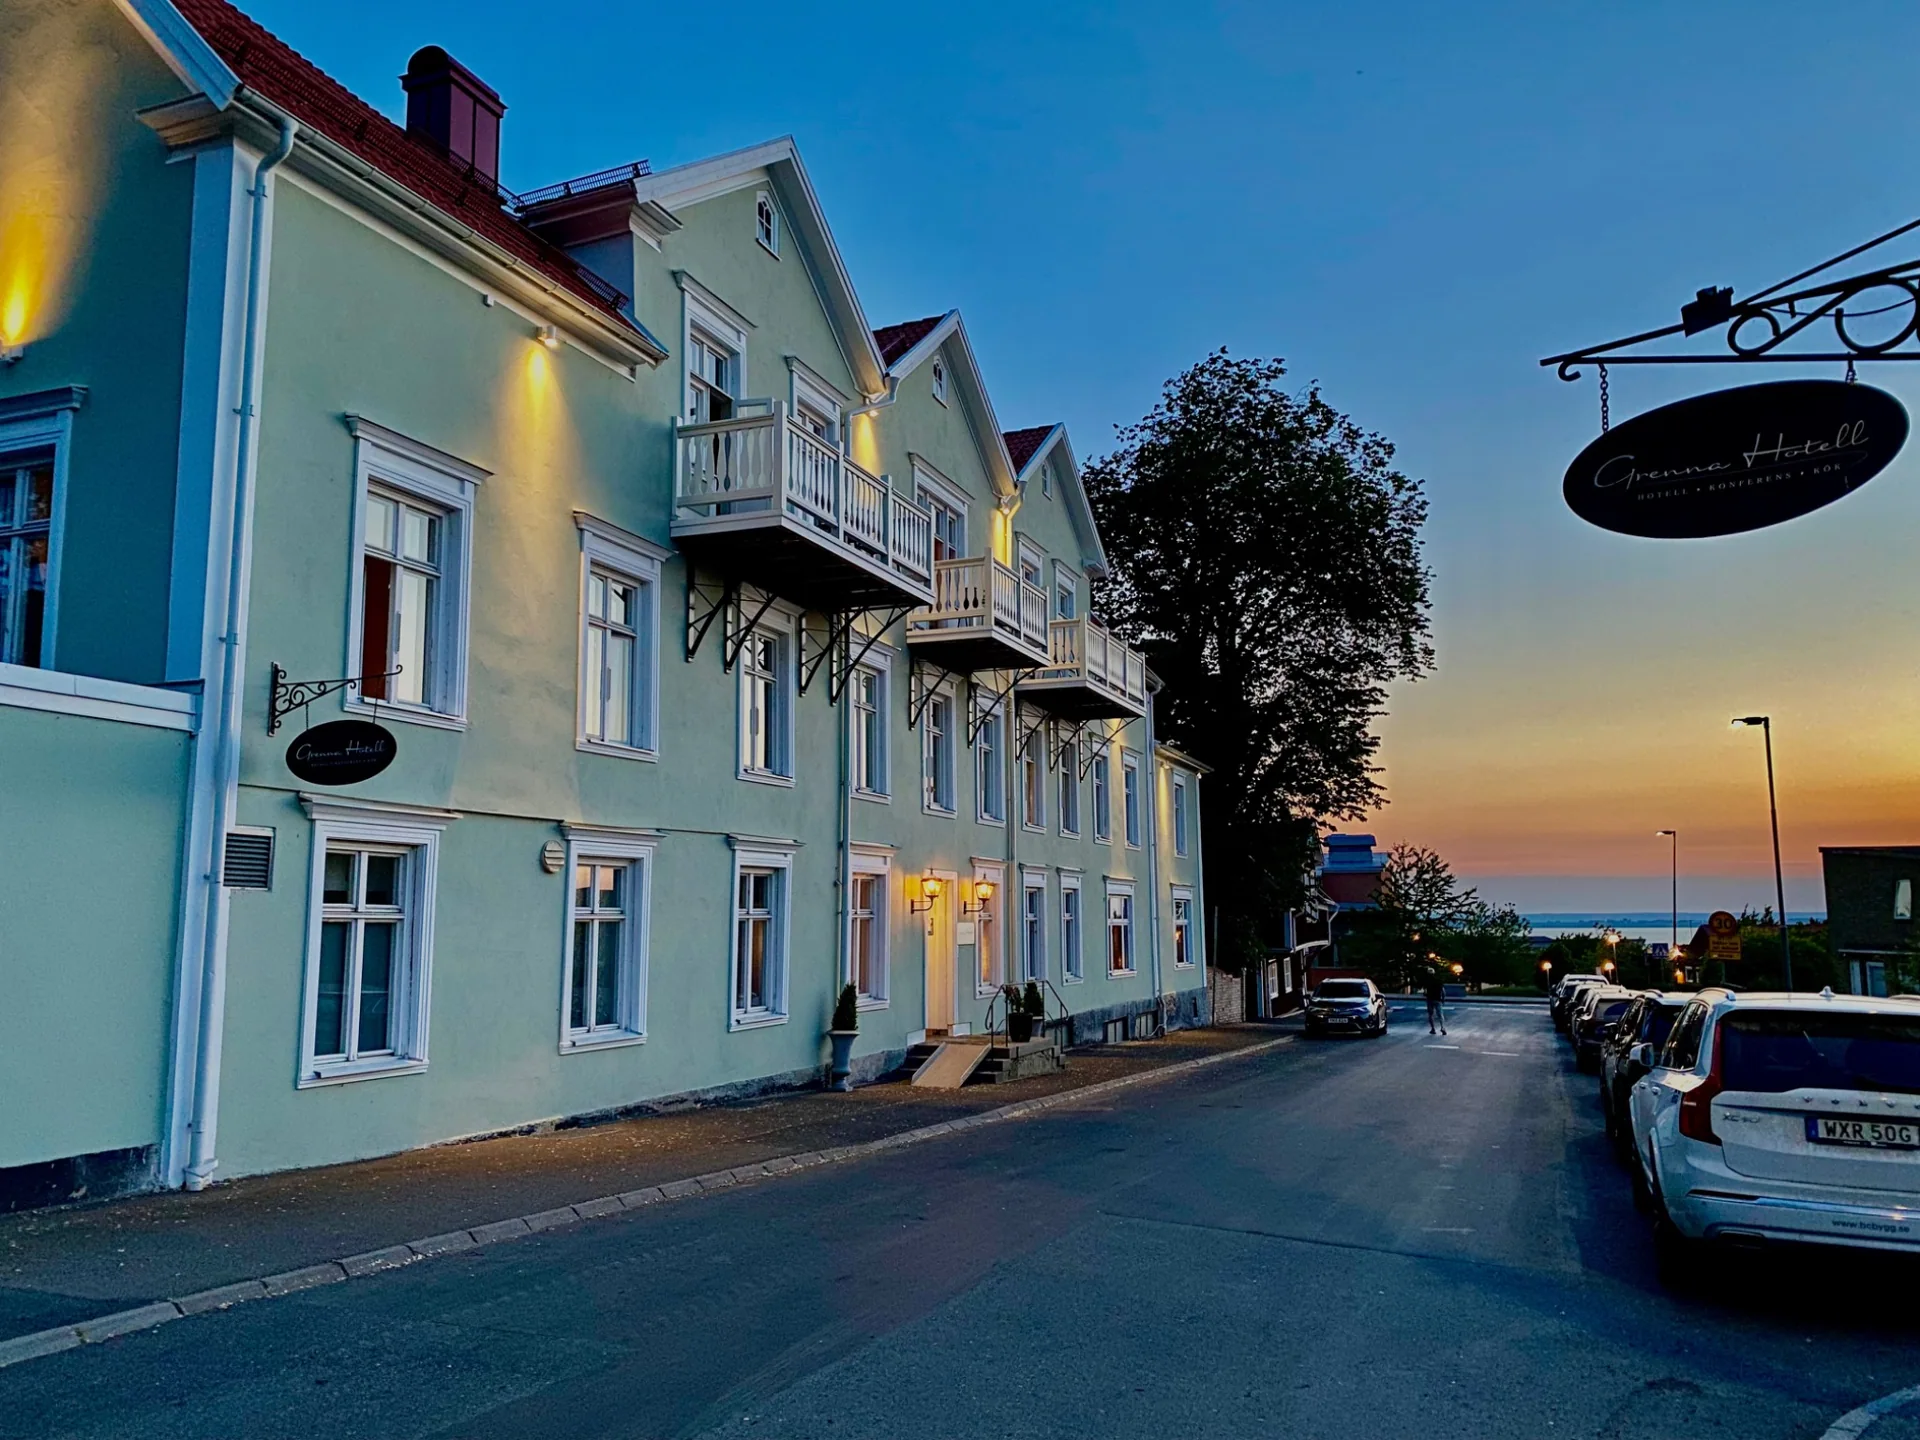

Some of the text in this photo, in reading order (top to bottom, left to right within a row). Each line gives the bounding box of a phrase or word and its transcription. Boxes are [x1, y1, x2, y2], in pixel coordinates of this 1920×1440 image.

[1594, 420, 1869, 490] Grenna Hotell
[1637, 487, 1688, 500] HOTELL
[1709, 475, 1792, 492] KONFERENS
[296, 740, 385, 761] Grenna Hotell
[1824, 1121, 1865, 1140] WXR
